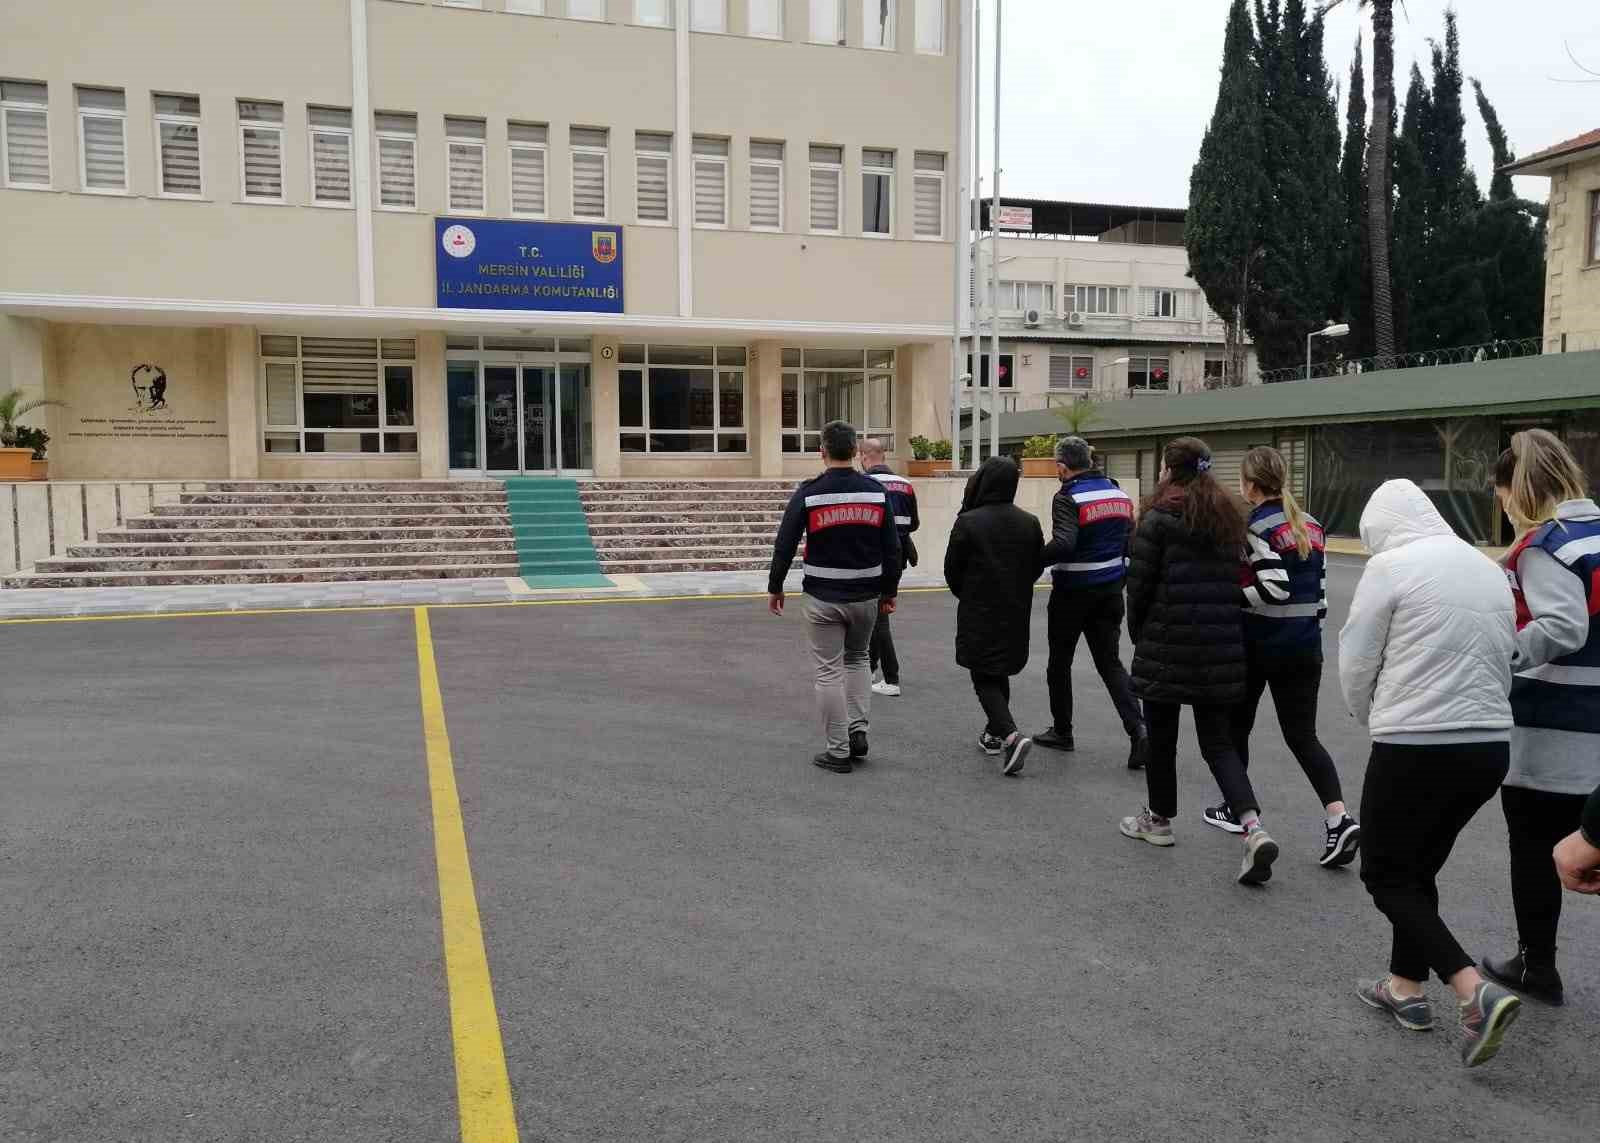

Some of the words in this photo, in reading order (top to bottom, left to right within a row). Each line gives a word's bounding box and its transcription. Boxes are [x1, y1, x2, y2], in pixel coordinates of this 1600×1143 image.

[519, 245, 544, 258] T.C.
[478, 263, 529, 277] MERSİN
[532, 264, 585, 279] VALİLİĞİ
[457, 281, 529, 297] JANDARMA
[534, 283, 619, 299] KOMUTANLIĞI
[815, 507, 881, 527] JANDARMA
